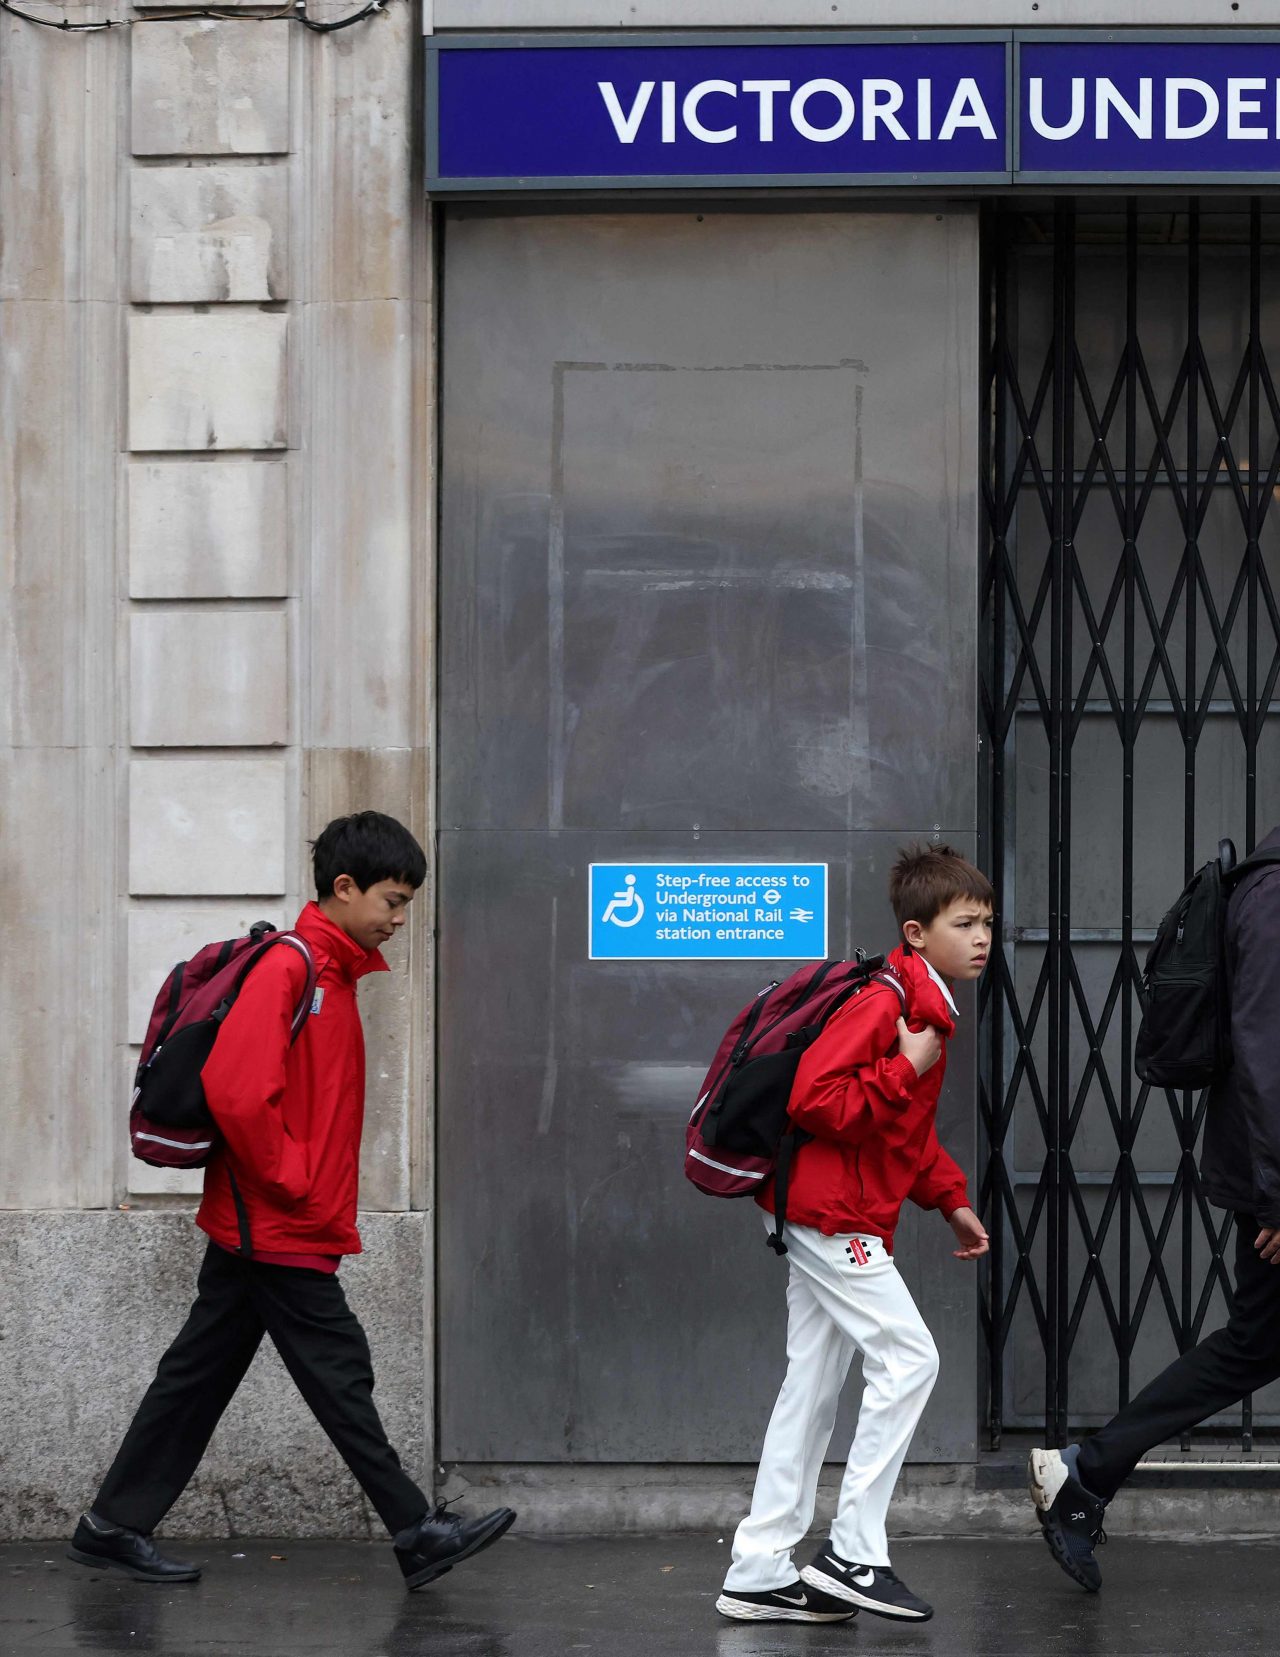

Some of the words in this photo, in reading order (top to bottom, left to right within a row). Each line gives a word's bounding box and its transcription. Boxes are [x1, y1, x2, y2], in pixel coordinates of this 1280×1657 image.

[598, 78, 998, 144] VICTORIA
[656, 873, 731, 889] Step-free
[736, 877, 788, 887] access
[793, 875, 810, 887] to
[656, 891, 757, 907] Underground
[656, 909, 678, 922] via
[683, 909, 749, 922] National
[755, 908, 783, 922] Rail
[656, 926, 711, 940] station
[716, 928, 785, 940] entrance
